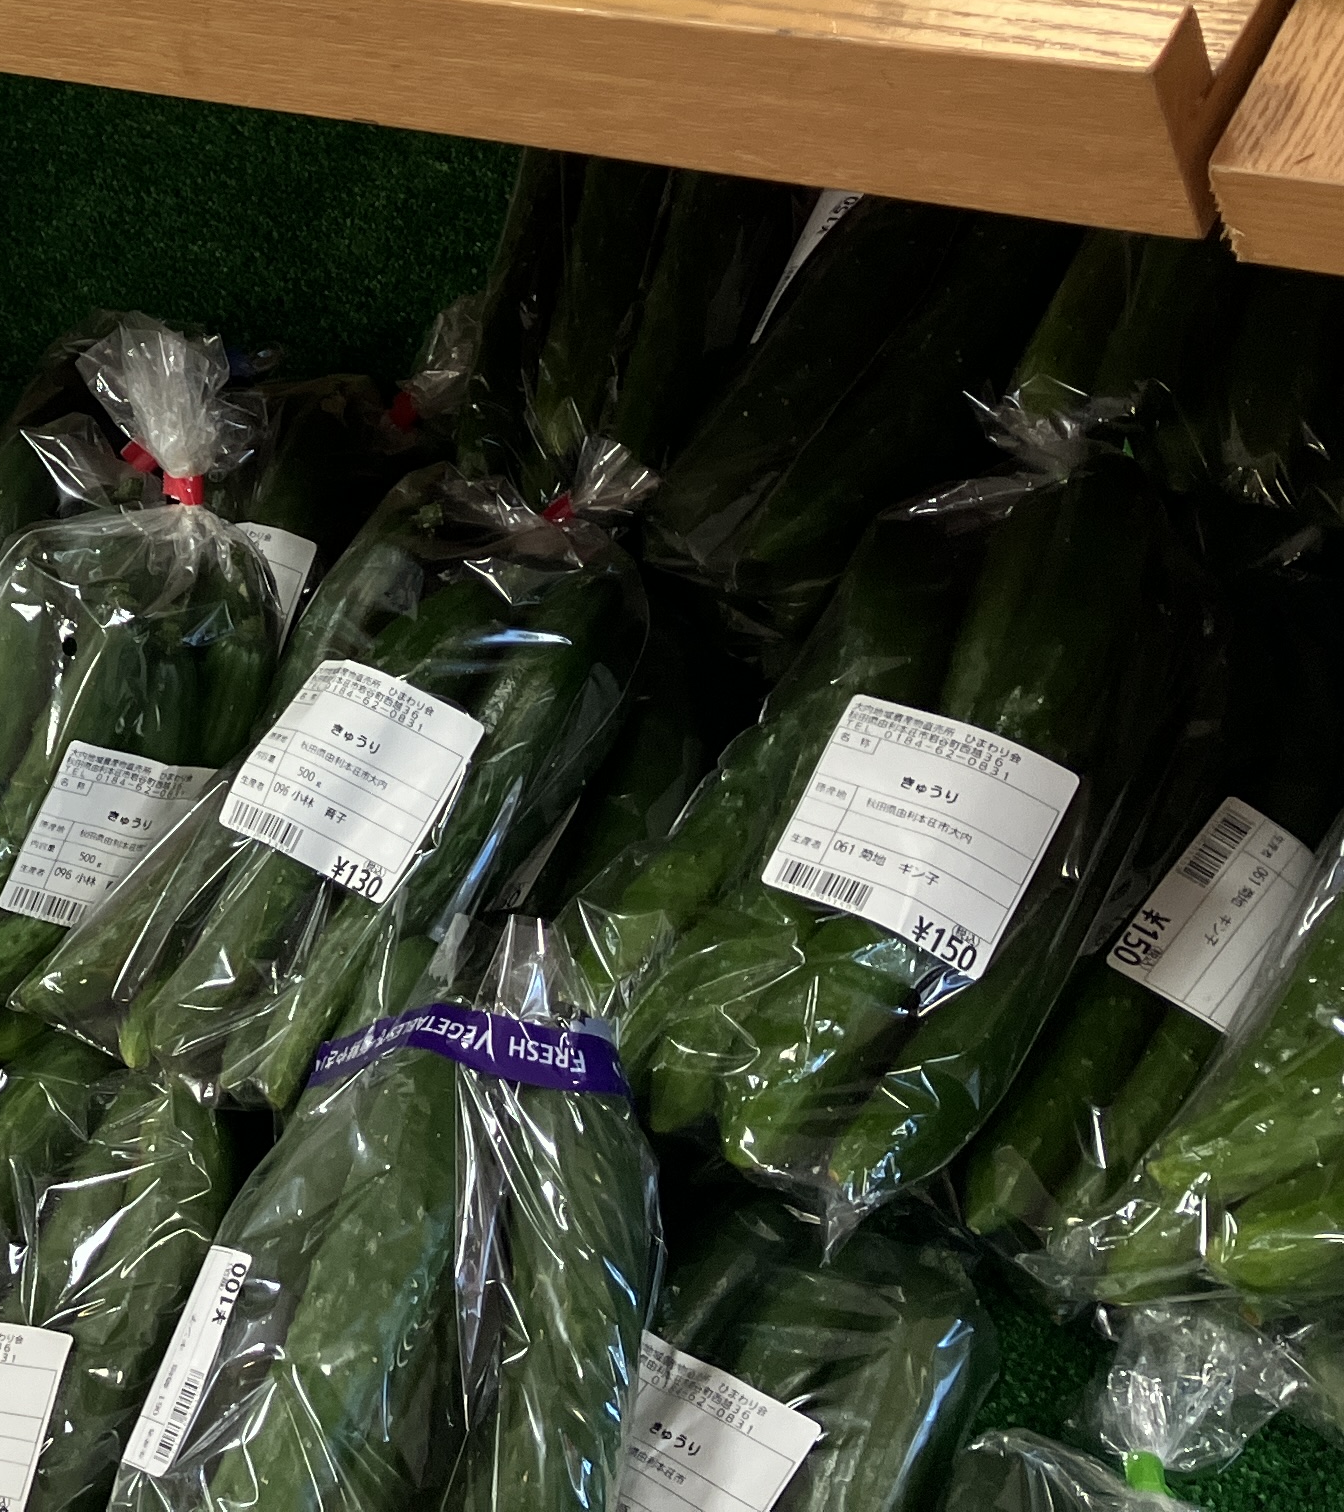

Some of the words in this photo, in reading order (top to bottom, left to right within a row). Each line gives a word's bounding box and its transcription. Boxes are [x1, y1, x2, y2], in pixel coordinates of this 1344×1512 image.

[388, 686, 435, 717] ひまわり会
[330, 723, 381, 754] きゅうり
[883, 730, 1009, 781] 0184-62-0831
[964, 732, 1022, 765] ひまわり会
[298, 766, 316, 782] 500
[301, 740, 388, 791] 秋田県由利本荘市大内
[273, 783, 289, 796] 096
[291, 790, 316, 808] 小林
[900, 776, 960, 804] きゅうり
[108, 810, 153, 831] きゅうり
[866, 797, 973, 844] 秋田県由利本荘市大内
[80, 851, 95, 864] 500
[833, 839, 856, 856] 061
[898, 863, 940, 885] ギン子
[54, 867, 72, 880] 096
[75, 874, 96, 886] 小林
[331, 856, 383, 899] ¥130
[1249, 865, 1269, 886] 061
[911, 915, 977, 972] ¥150
[1114, 909, 1171, 966] ¥150
[507, 1034, 586, 1073] FRESH
[212, 1263, 247, 1325] ¥100
[718, 1383, 768, 1417] ひまわり会
[649, 1422, 701, 1456] きゅうり
